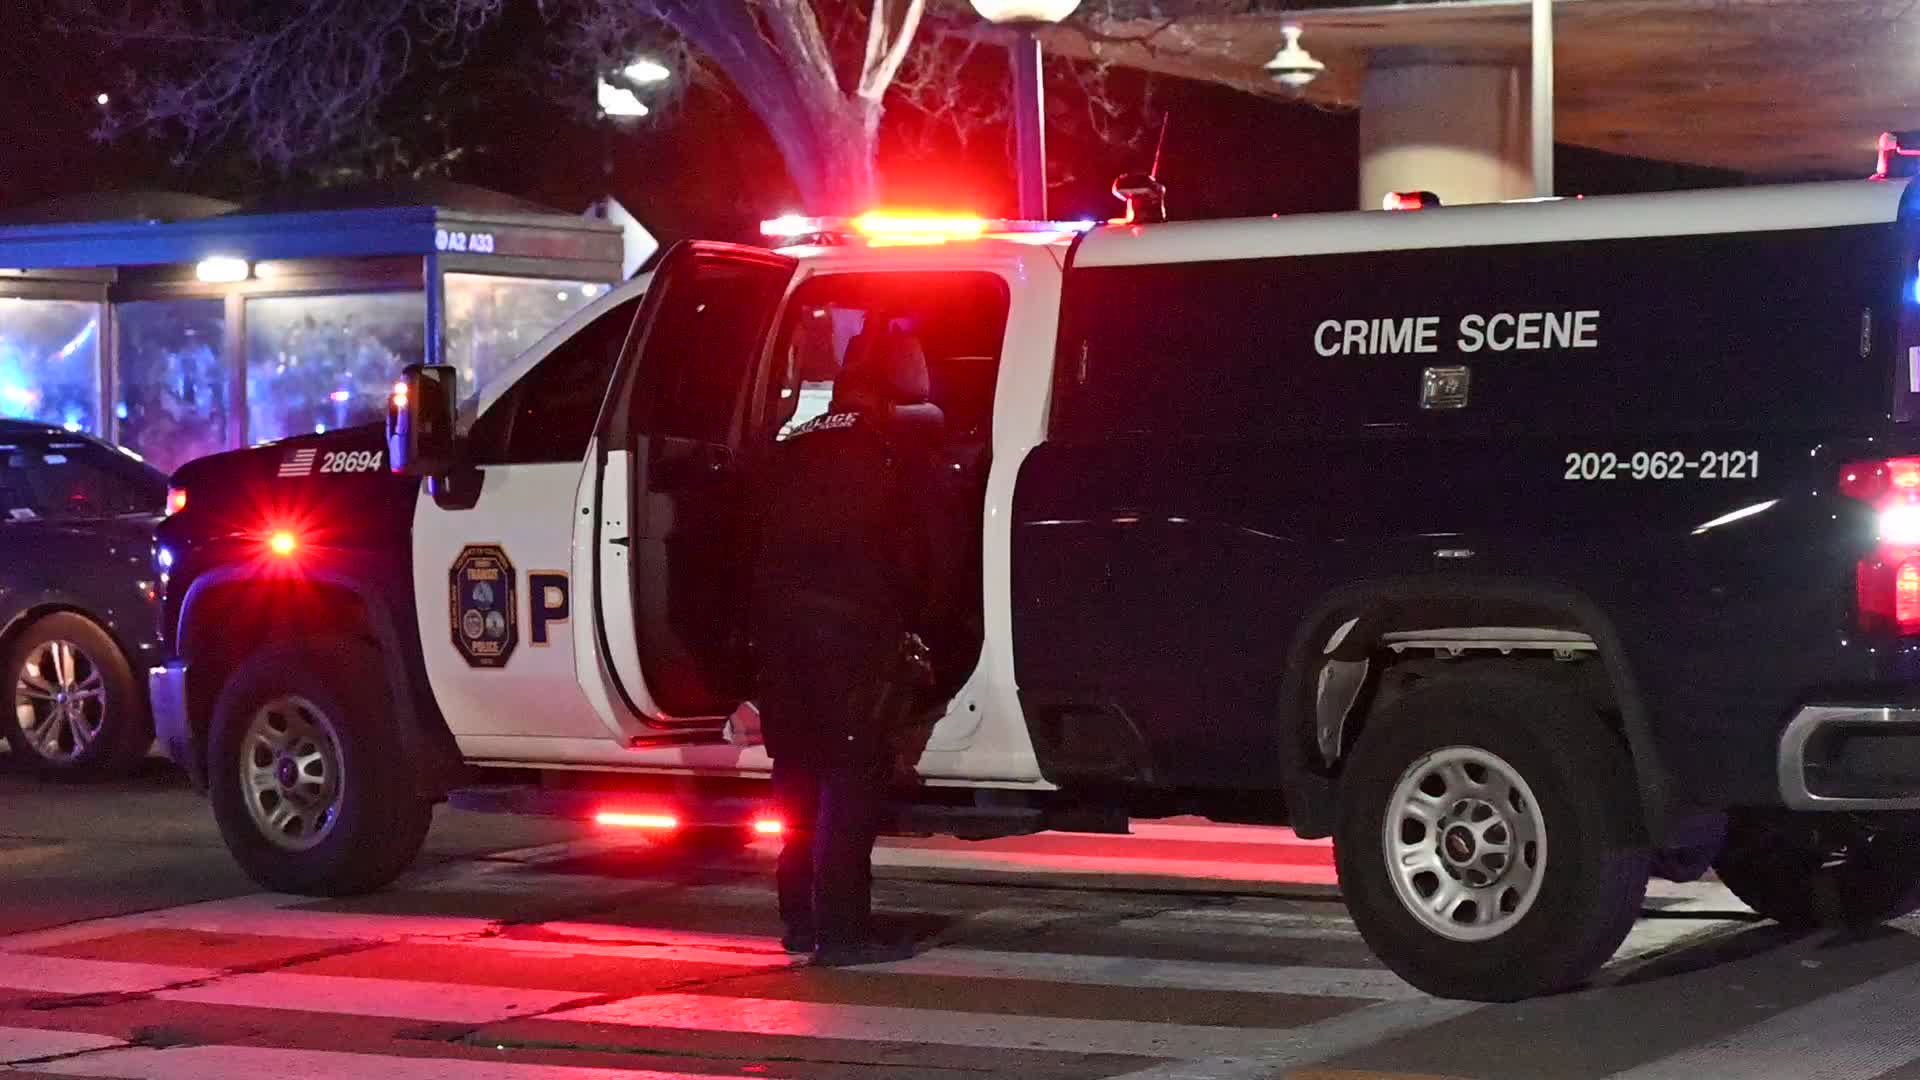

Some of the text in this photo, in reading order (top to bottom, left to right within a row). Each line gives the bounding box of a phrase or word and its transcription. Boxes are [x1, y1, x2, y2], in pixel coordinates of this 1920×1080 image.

[1314, 310, 1600, 357] CRIME SCENE
[320, 450, 382, 473] 28694
[1564, 451, 1759, 480] 202-962-2121
[528, 569, 569, 648] P
